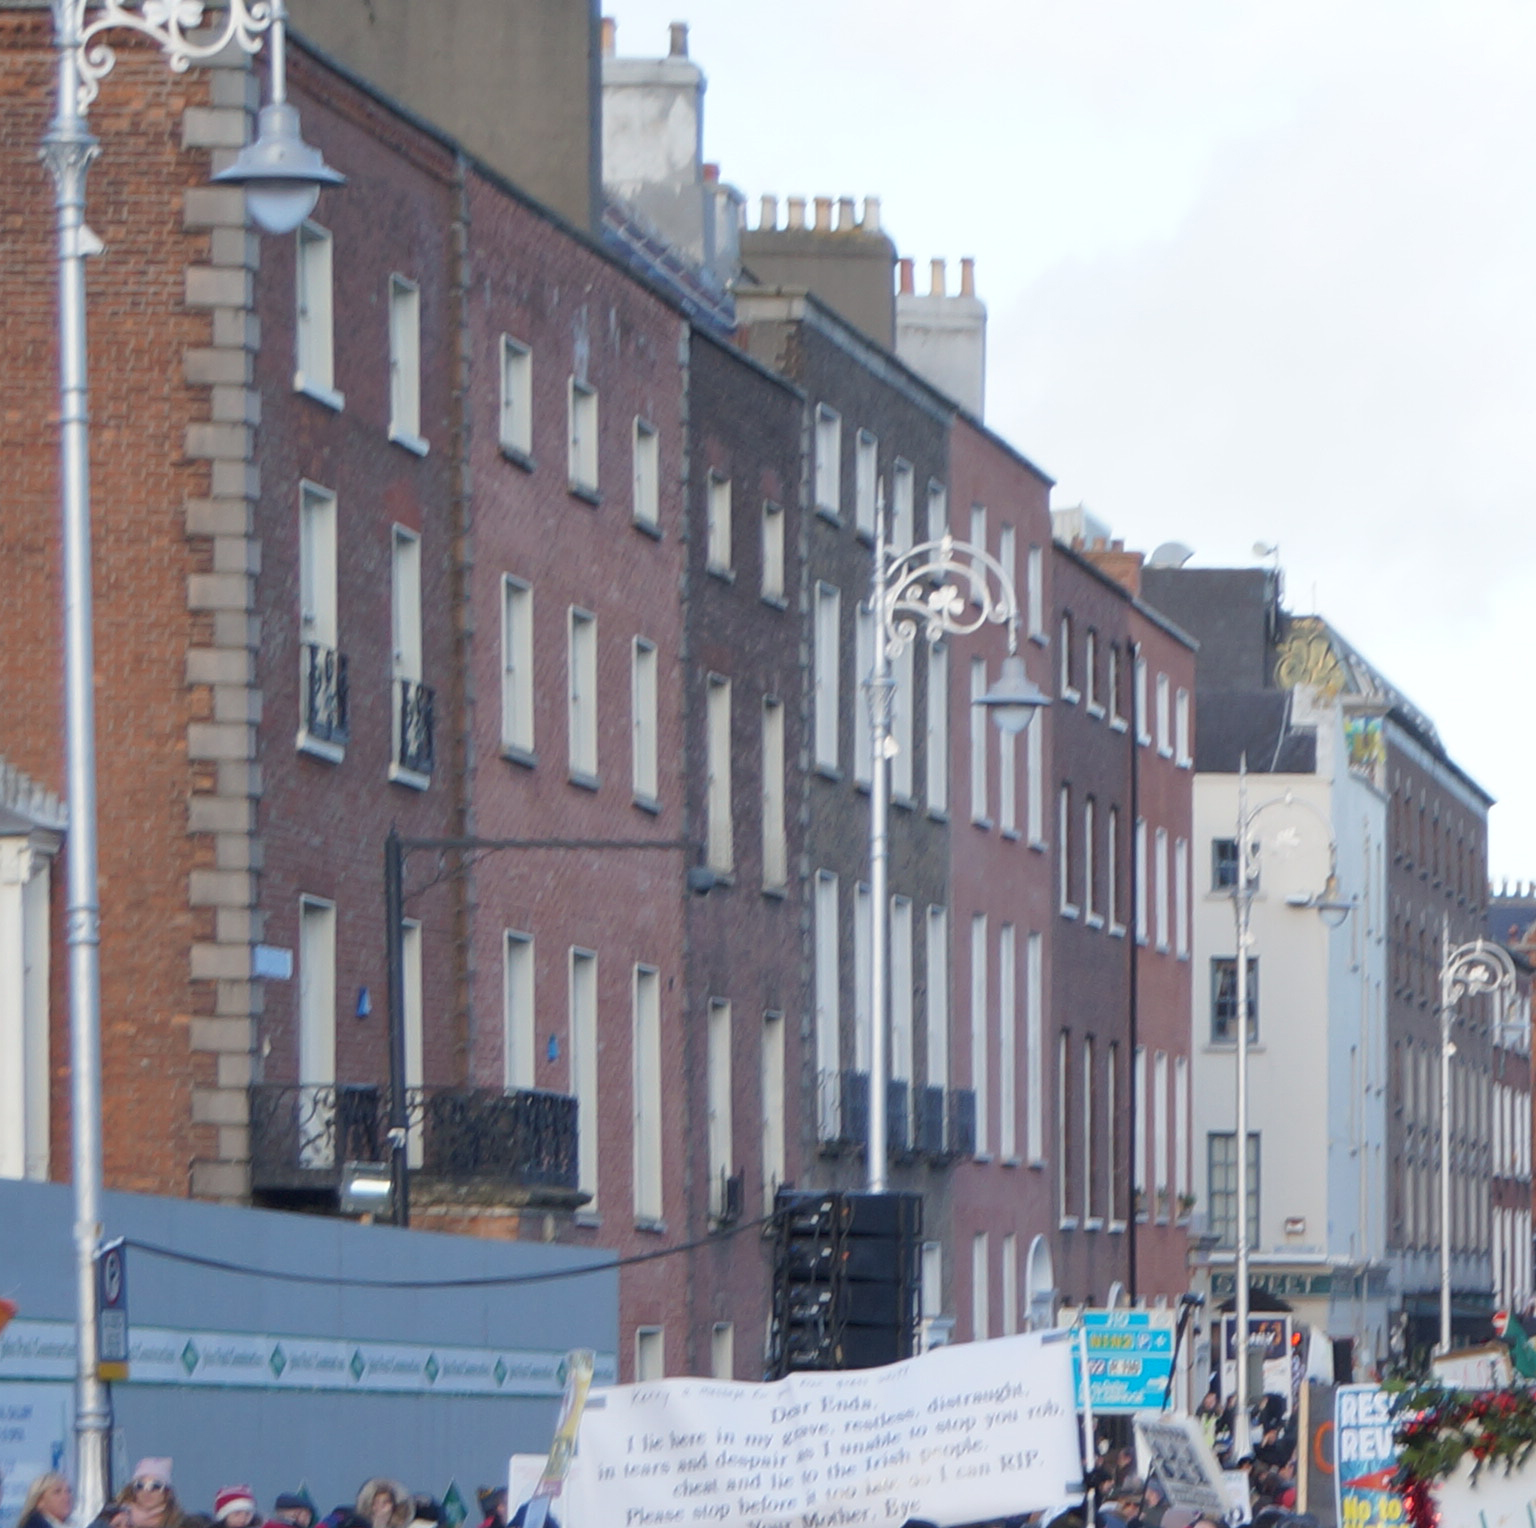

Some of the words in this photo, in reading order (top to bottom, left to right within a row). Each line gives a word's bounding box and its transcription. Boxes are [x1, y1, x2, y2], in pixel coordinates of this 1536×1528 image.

[598, 1462, 617, 1482] in
[623, 1460, 671, 1478] tears
[676, 1450, 709, 1473] and
[715, 1448, 789, 1471] despair
[908, 1424, 929, 1440] to
[934, 1416, 977, 1434] stop
[983, 1411, 1019, 1429] you
[641, 1432, 664, 1451] lie
[670, 1429, 707, 1448] here
[715, 1426, 736, 1445] in
[744, 1432, 773, 1449] my
[625, 1503, 685, 1528] Please
[692, 1500, 731, 1523] stop
[738, 1492, 797, 1516] before
[956, 1460, 991, 1478] can
[672, 1476, 720, 1499] cheat
[725, 1471, 762, 1491] and
[770, 1471, 794, 1490] lie
[801, 1467, 819, 1484] to
[826, 1460, 858, 1480] the
[865, 1446, 911, 1471] Irish
[1343, 1495, 1372, 1522] No
[1377, 1496, 1403, 1521] to
